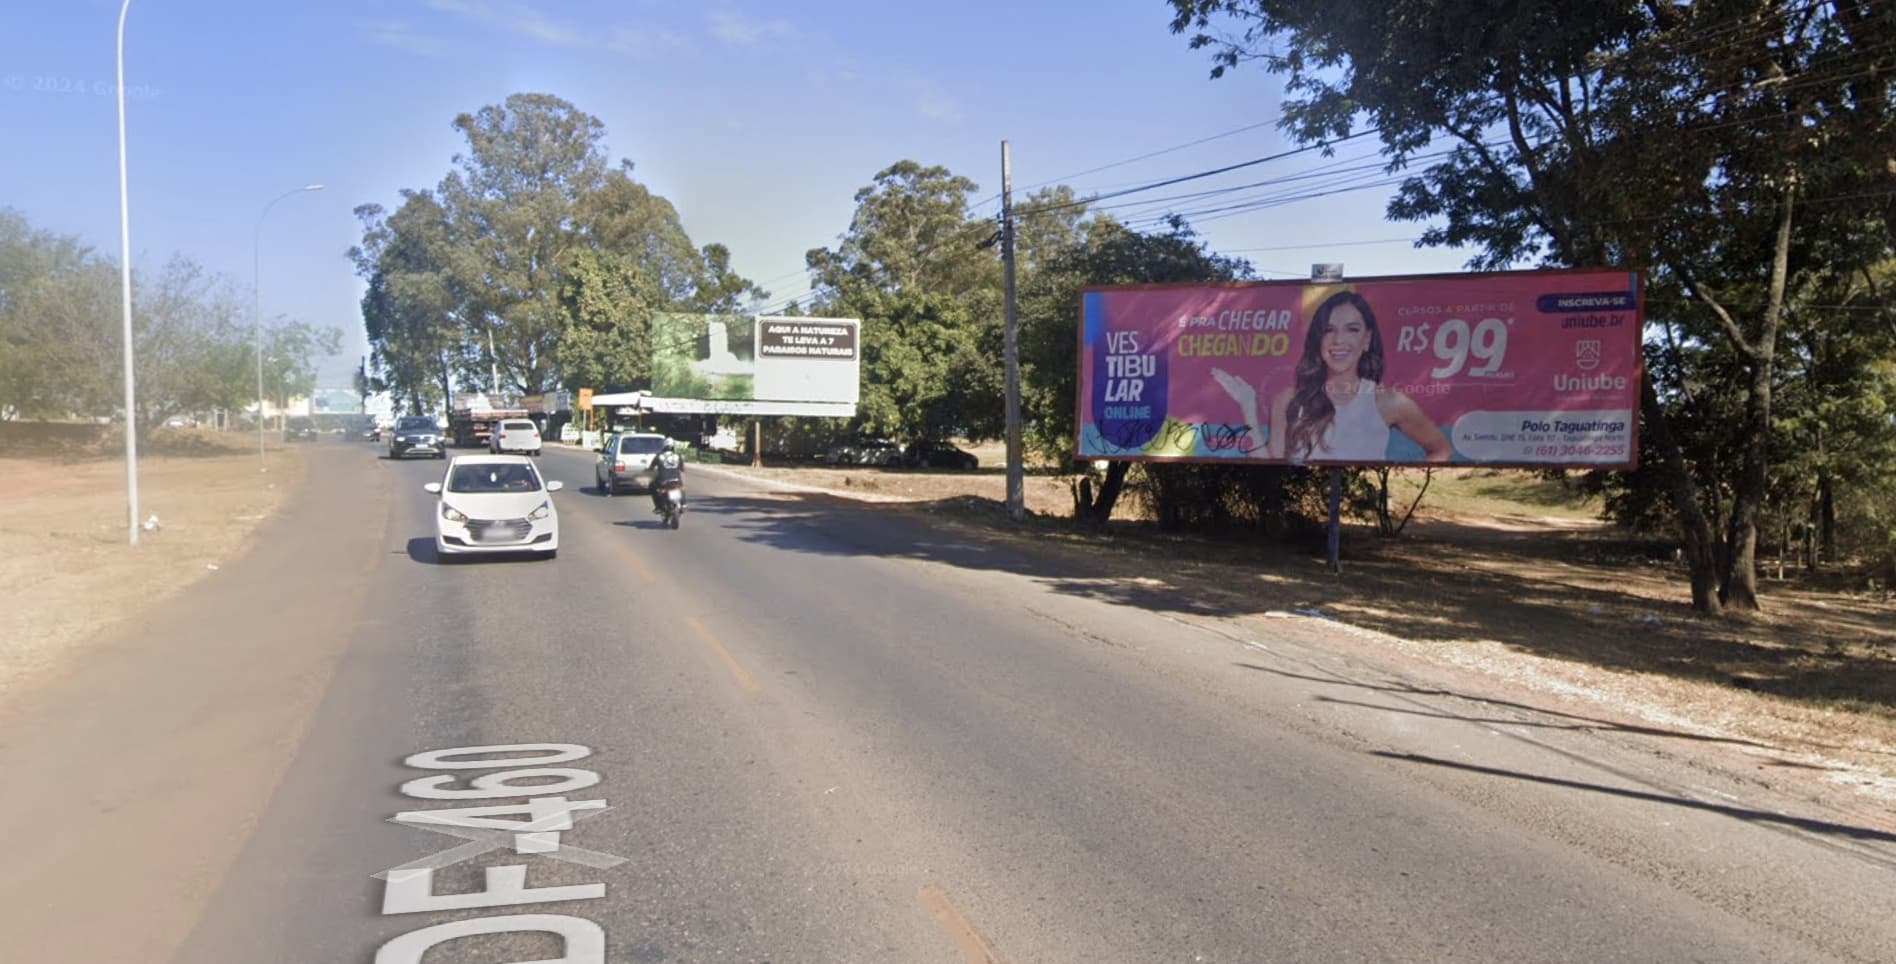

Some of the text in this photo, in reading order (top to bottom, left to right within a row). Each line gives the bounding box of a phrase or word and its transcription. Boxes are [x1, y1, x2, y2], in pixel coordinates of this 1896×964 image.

[1558, 297, 1627, 308] INSCREVA-SE
[1190, 316, 1216, 327] PRA
[1218, 310, 1292, 331] CHEGAR
[1561, 314, 1625, 329] uniube.br
[768, 325, 849, 336] AQUI A NATUREZA
[1398, 323, 1430, 352] R$
[782, 336, 835, 346] TE LEVA A 7
[1106, 331, 1139, 354] VES
[1178, 333, 1290, 357] CHEGANDO
[808, 347, 854, 356] NATURAIS
[1105, 355, 1156, 378] TIBU
[1553, 372, 1626, 392] Uniube
[1104, 380, 1145, 402] LAR
[1104, 406, 1151, 420] ONLINE
[1521, 420, 1625, 434] Polo Taguatinga
[1535, 444, 1625, 457] (61) 3046-2255
